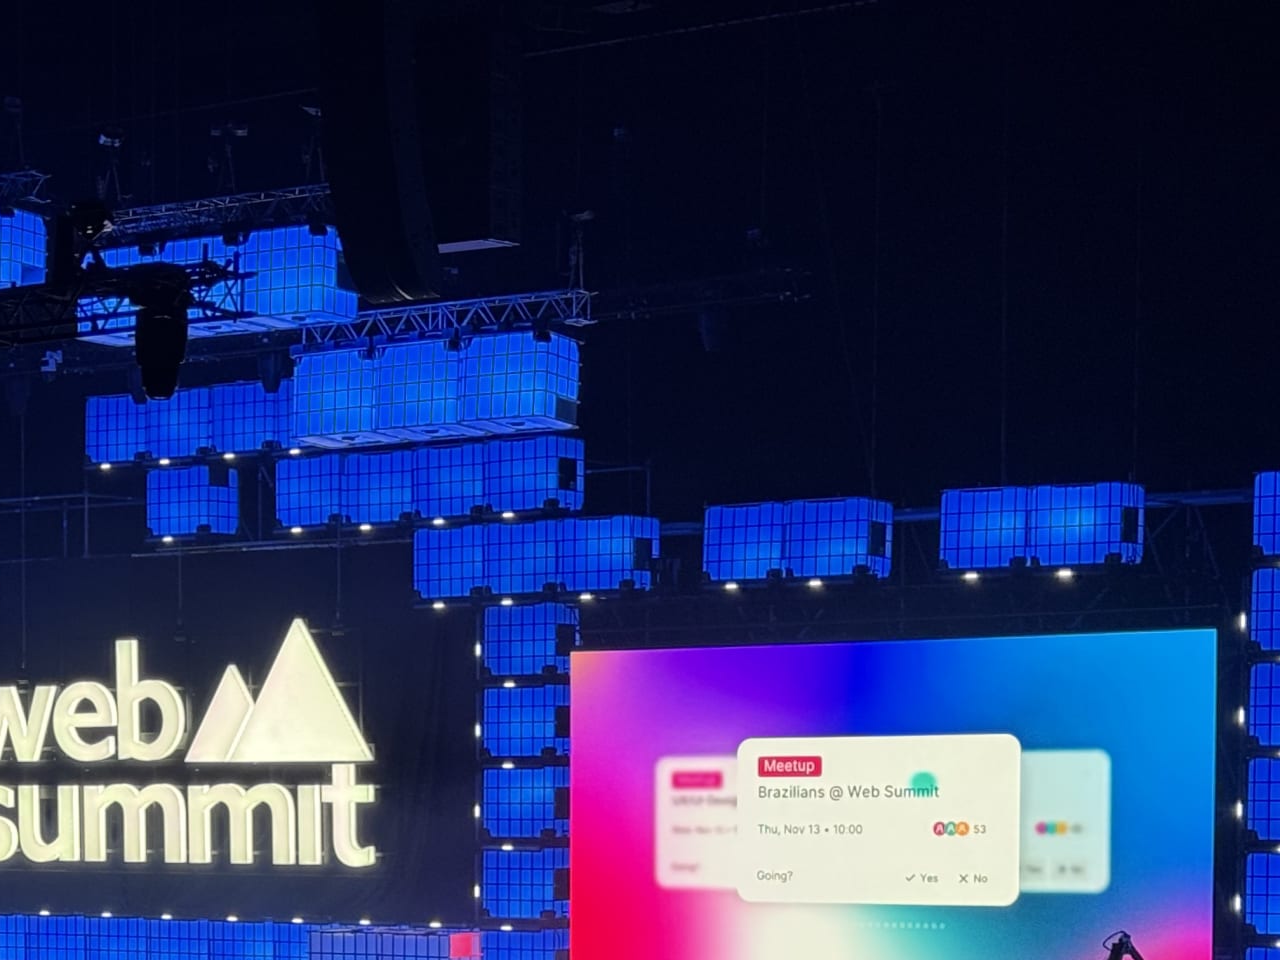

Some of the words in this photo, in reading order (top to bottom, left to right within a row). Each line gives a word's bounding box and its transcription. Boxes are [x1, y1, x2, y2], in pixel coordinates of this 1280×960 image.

[764, 759, 816, 775] Meetup
[758, 785, 825, 798] Brazilians
[829, 785, 844, 801] @
[847, 785, 880, 798] Web
[884, 785, 939, 798] Summit
[758, 823, 781, 836] Thu,
[783, 823, 806, 835] Nov
[808, 823, 821, 835] 13
[833, 823, 864, 835] 10:00
[973, 824, 987, 834] 53
[756, 870, 794, 882] Going?
[920, 873, 939, 883] Yes
[973, 873, 988, 883] No
